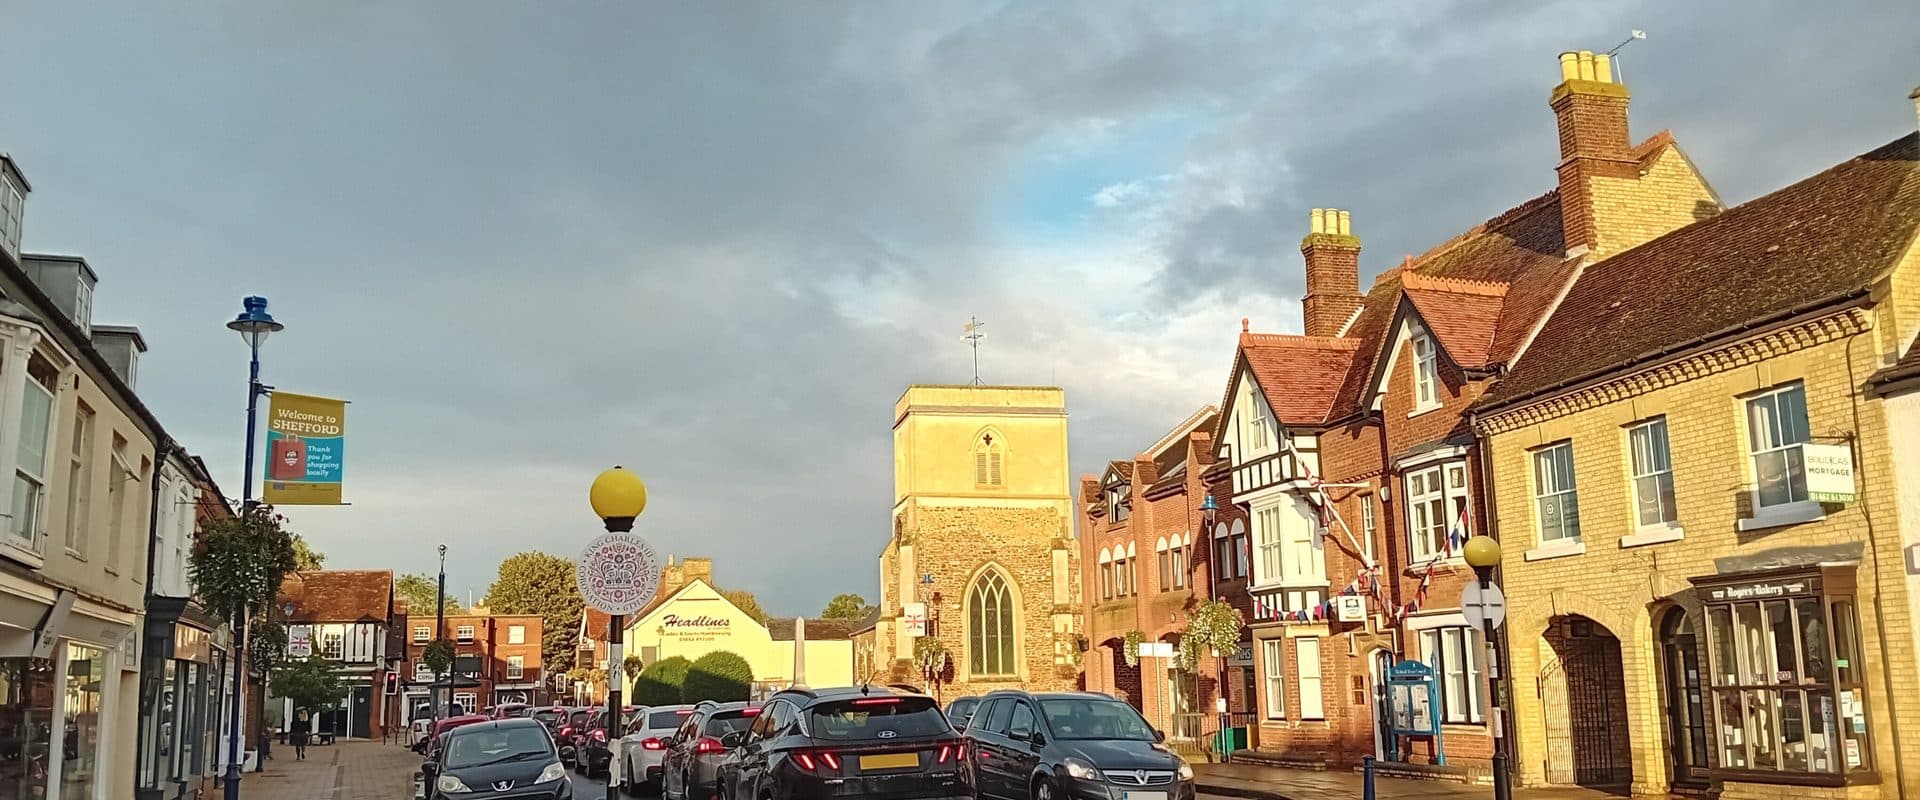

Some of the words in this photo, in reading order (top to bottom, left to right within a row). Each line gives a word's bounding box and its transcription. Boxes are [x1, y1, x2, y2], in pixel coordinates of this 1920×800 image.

[278, 409, 324, 421] Welcome
[326, 415, 337, 423] to
[273, 419, 340, 435] SHEFFORD
[307, 445, 331, 453] Thank
[306, 454, 320, 462] you
[321, 453, 332, 462] for
[306, 461, 340, 470] shopping
[1809, 467, 1849, 476] MORTGAGE
[306, 469, 329, 478] locally
[585, 540, 604, 558] KING
[605, 535, 644, 550] CHARLES
[579, 565, 613, 611] CORONATION
[1726, 586, 1753, 599] Rogers
[1754, 583, 1783, 596] Bakery
[663, 614, 730, 627] Headlines
